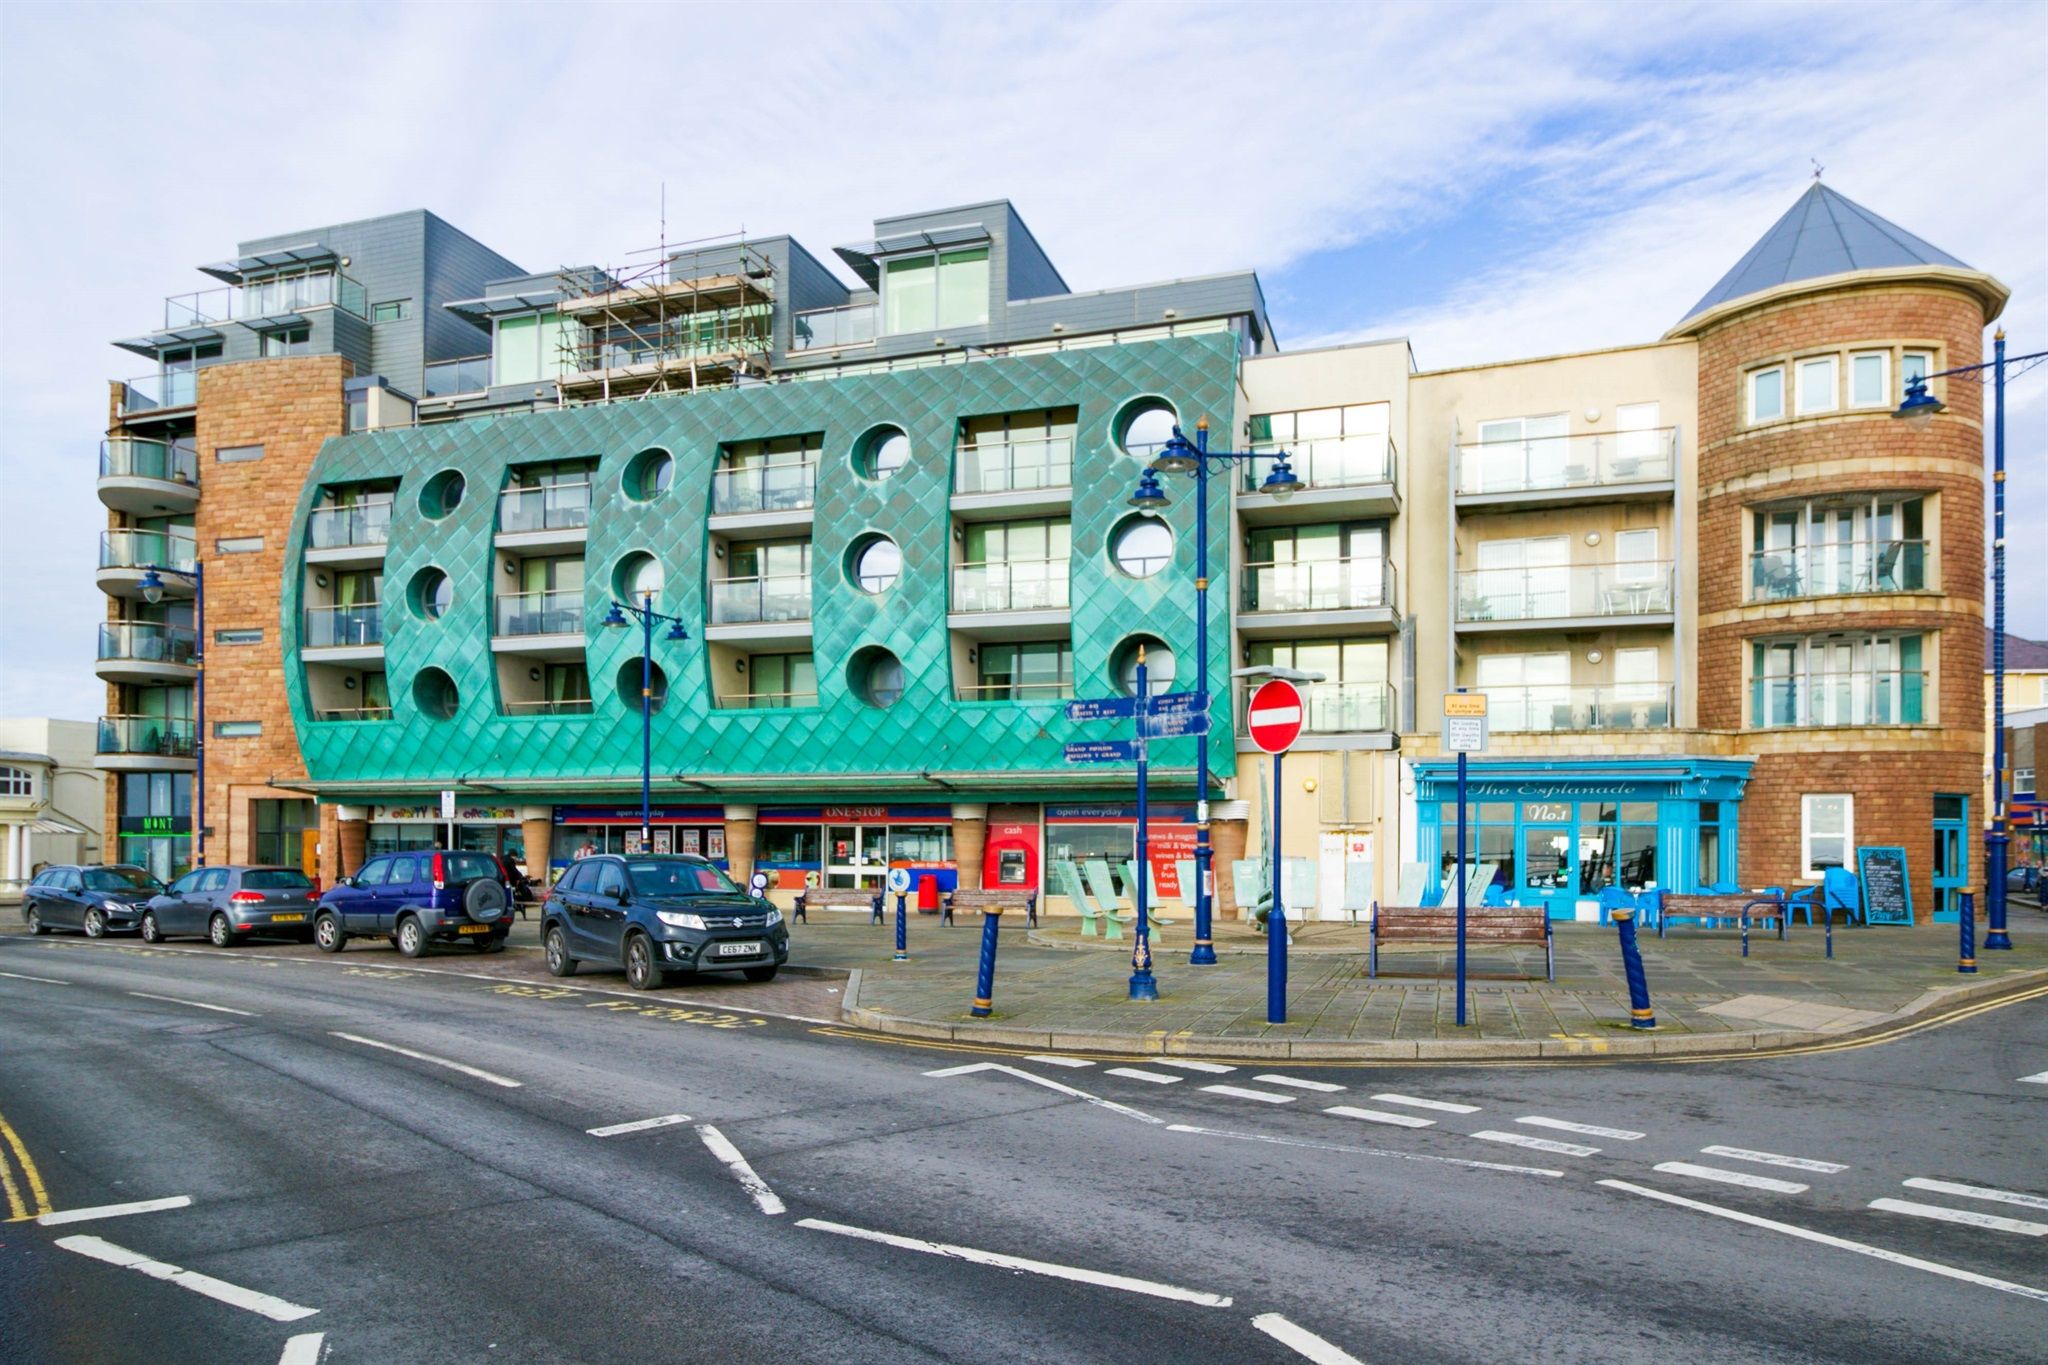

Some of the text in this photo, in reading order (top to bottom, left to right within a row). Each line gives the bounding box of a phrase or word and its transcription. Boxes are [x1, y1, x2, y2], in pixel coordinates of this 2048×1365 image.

[1466, 781, 1637, 799] The Esplanade
[616, 809, 633, 817] open
[1056, 808, 1123, 817] open everyday
[1529, 804, 1567, 821] No.1
[1004, 826, 1022, 834] cash
[1159, 881, 1177, 889] ready
